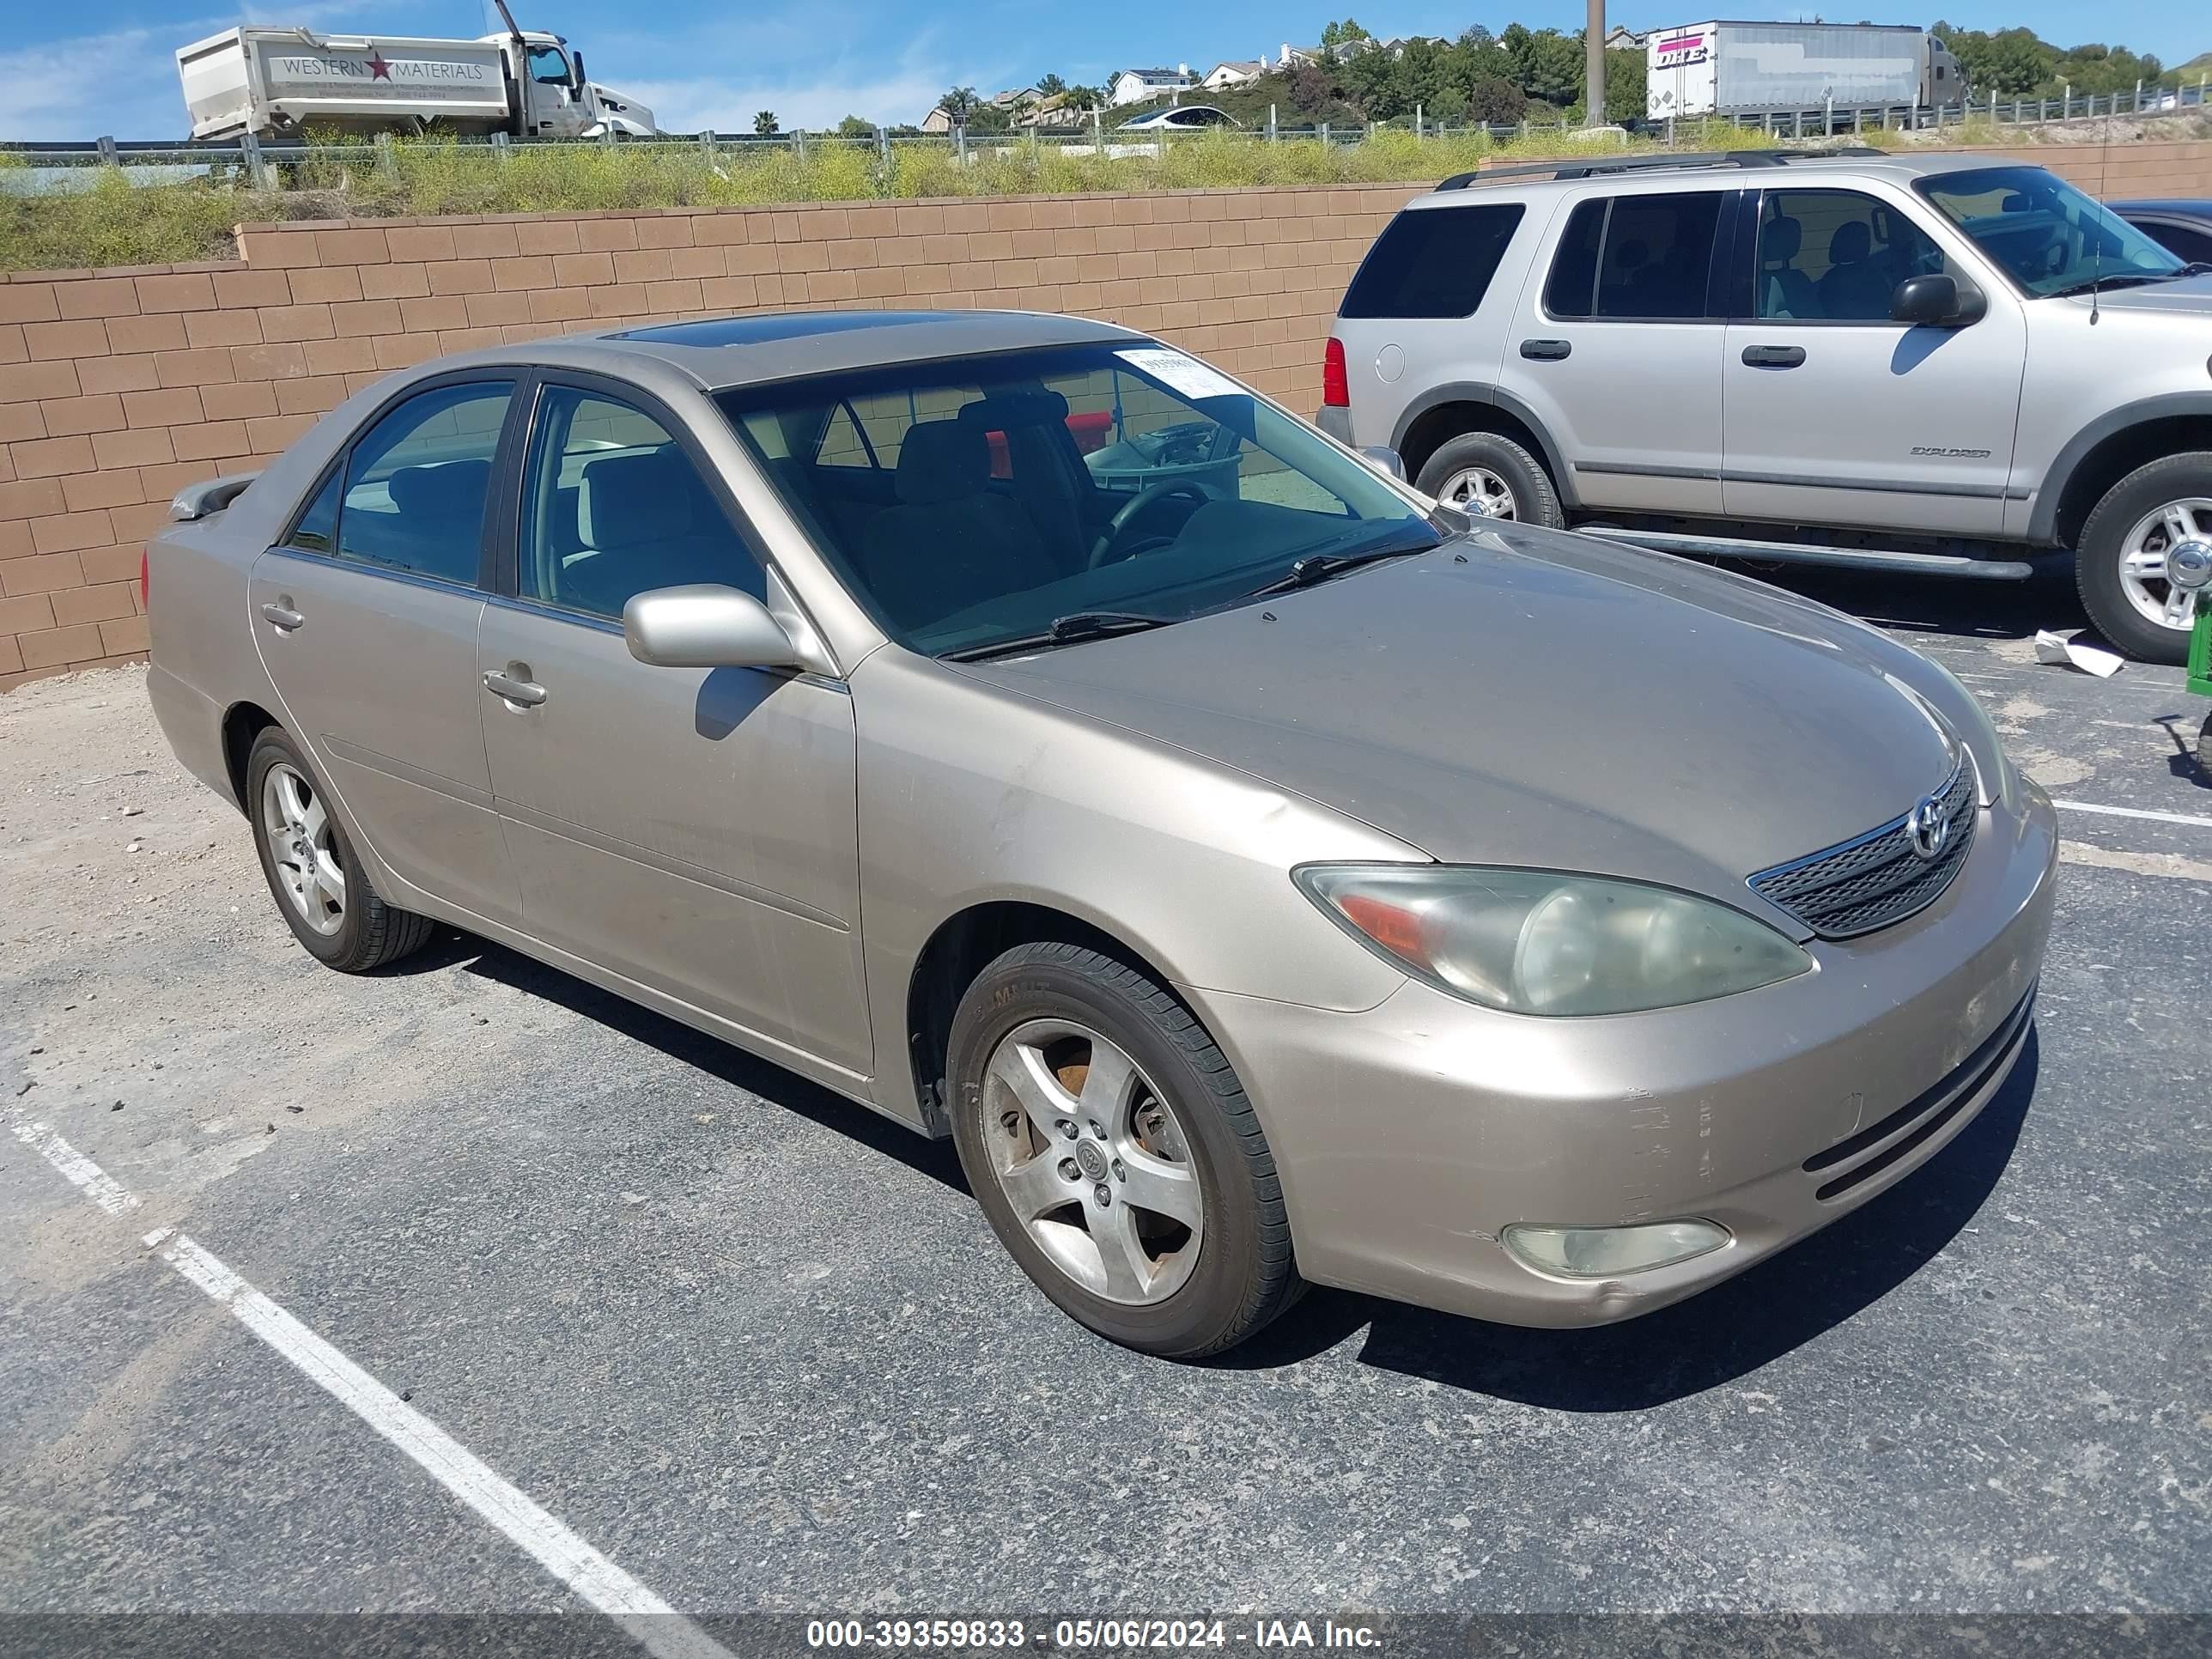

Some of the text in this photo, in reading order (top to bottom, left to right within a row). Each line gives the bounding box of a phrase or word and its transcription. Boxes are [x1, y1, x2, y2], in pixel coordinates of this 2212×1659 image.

[283, 58, 483, 80] WESTERN MATERIALS
[1910, 446, 1991, 459] EXPLORER
